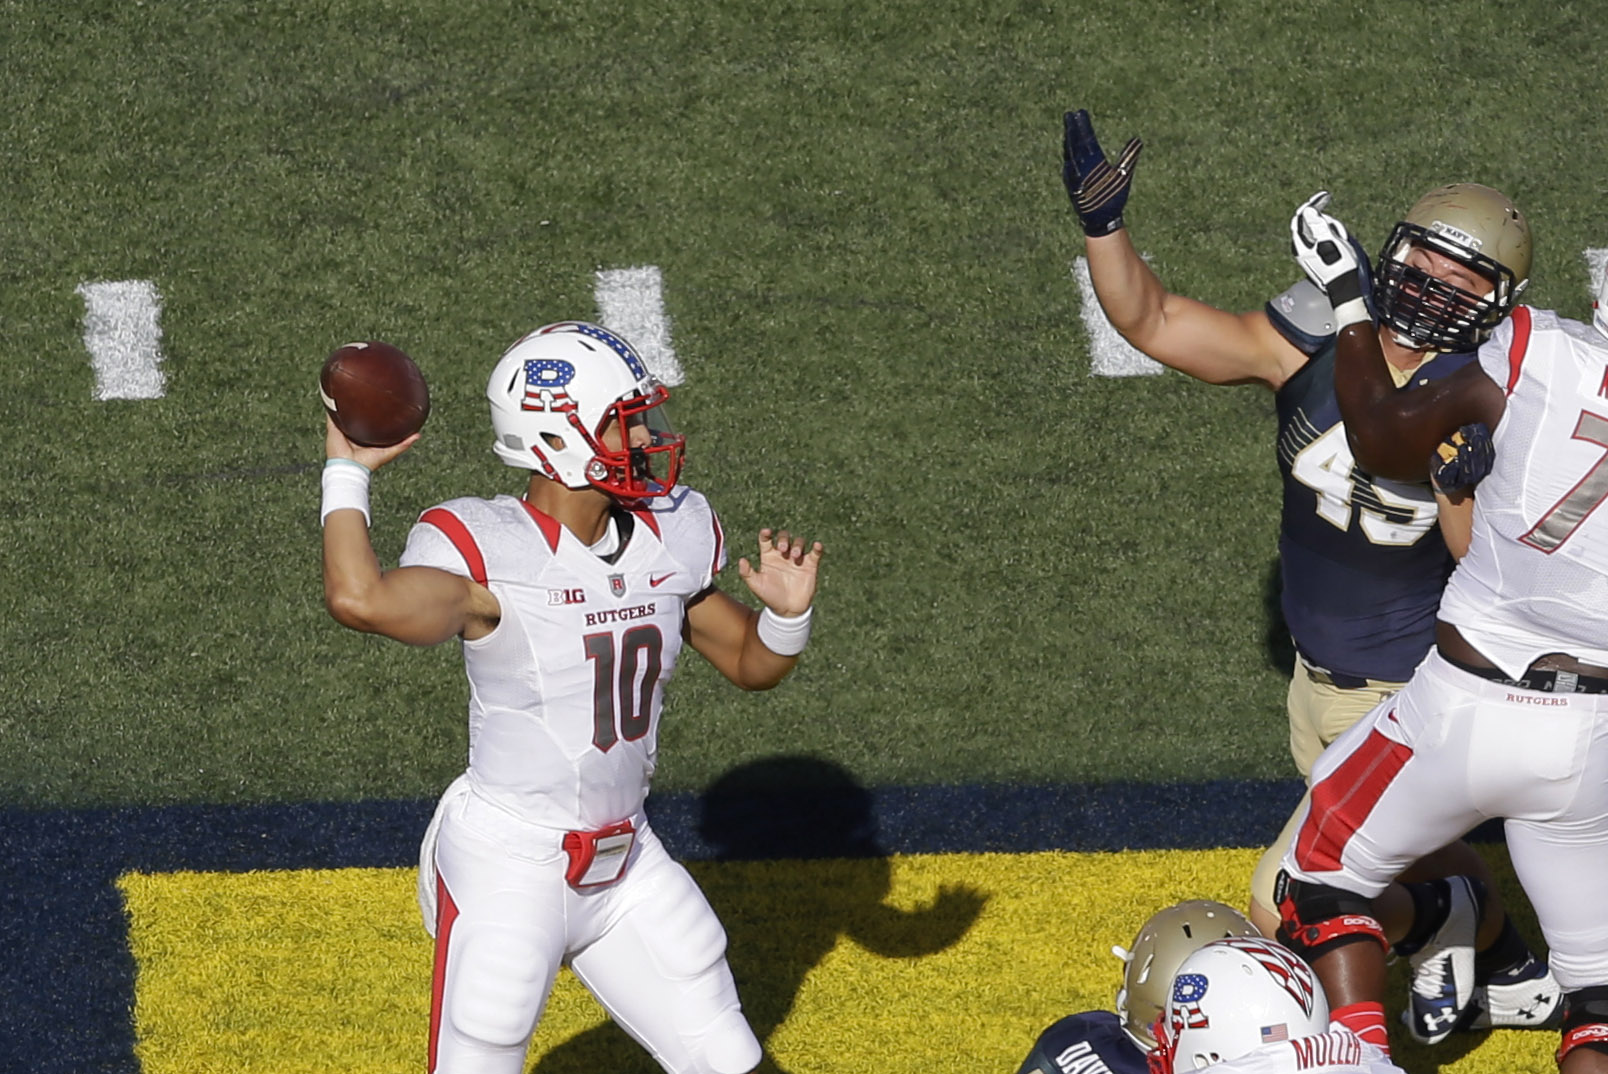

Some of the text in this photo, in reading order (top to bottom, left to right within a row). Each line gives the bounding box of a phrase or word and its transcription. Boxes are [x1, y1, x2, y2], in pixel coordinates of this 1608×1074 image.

[584, 603, 656, 627] RUTGERS
[583, 624, 664, 754] 10
[1506, 692, 1568, 707] RUTGERS
